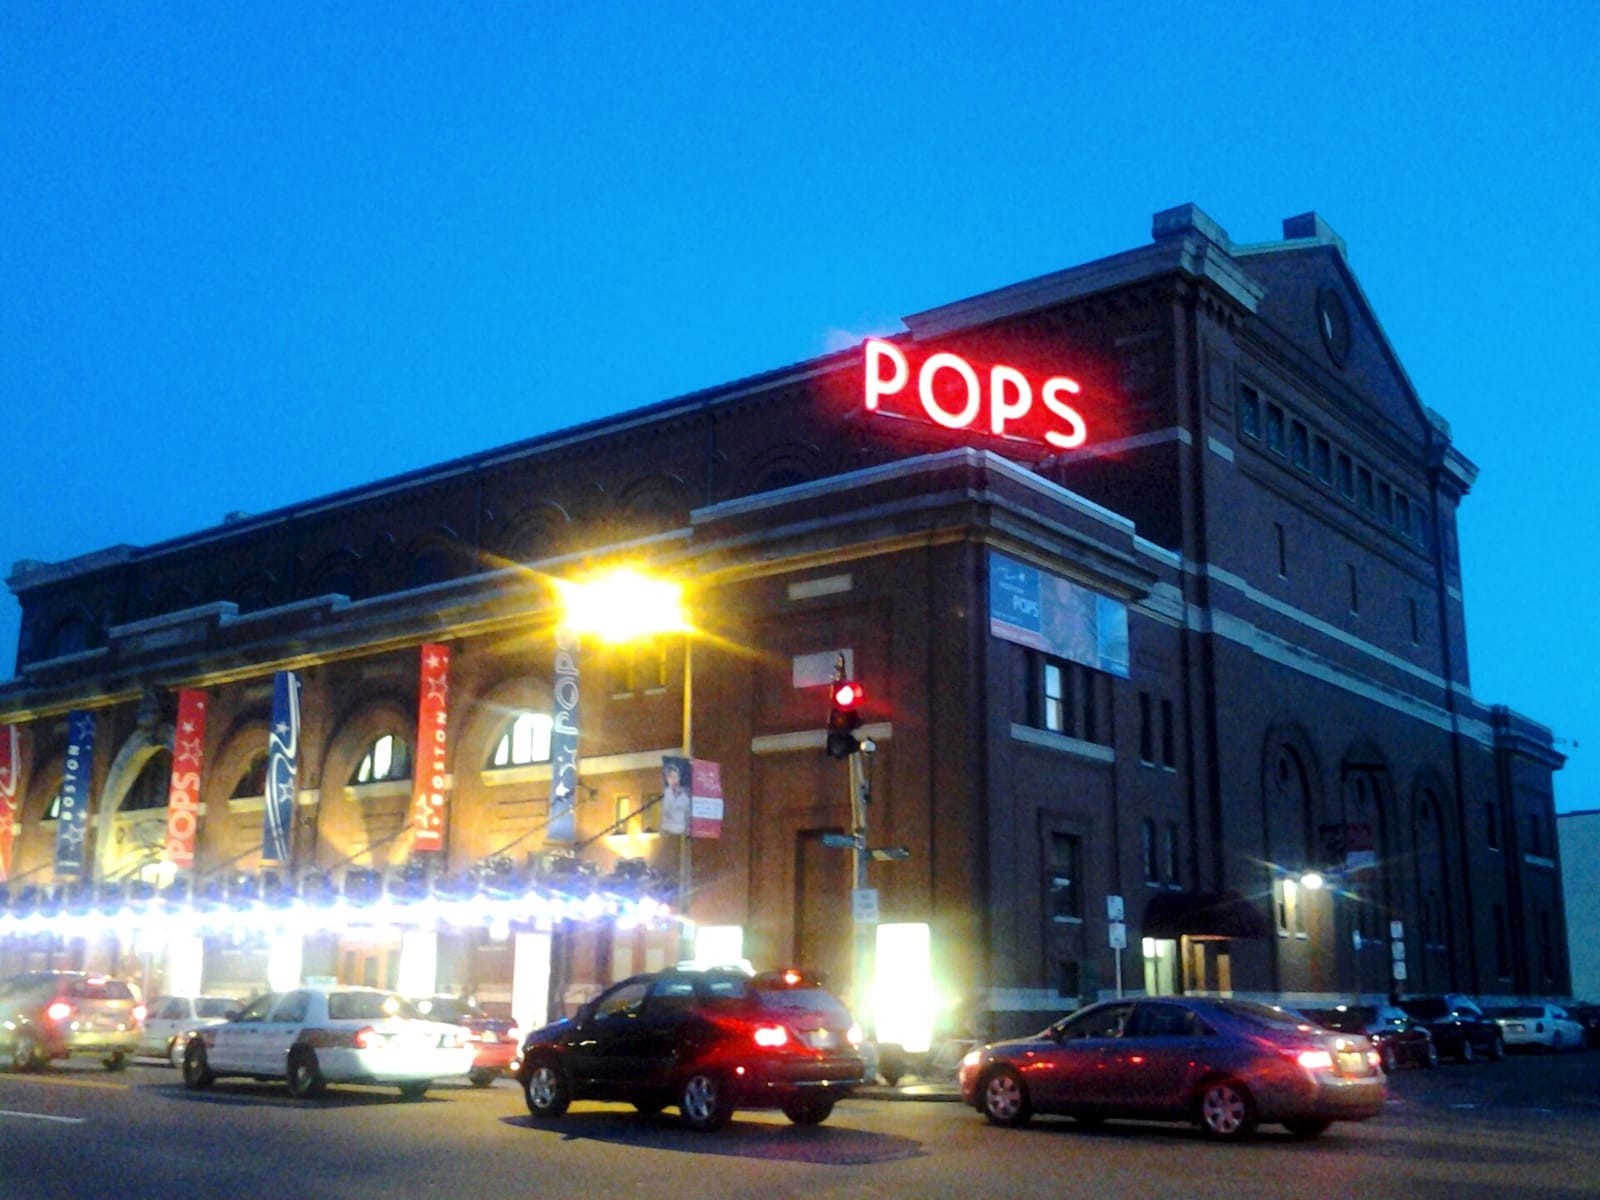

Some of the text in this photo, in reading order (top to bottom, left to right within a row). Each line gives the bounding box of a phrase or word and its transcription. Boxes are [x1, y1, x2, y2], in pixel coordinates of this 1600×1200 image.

[864, 338, 1087, 449] POPS
[1013, 594, 1040, 618] POPS
[61, 744, 81, 821] BOSTON
[432, 712, 447, 806] BOSTON
[168, 771, 201, 861] POPS
